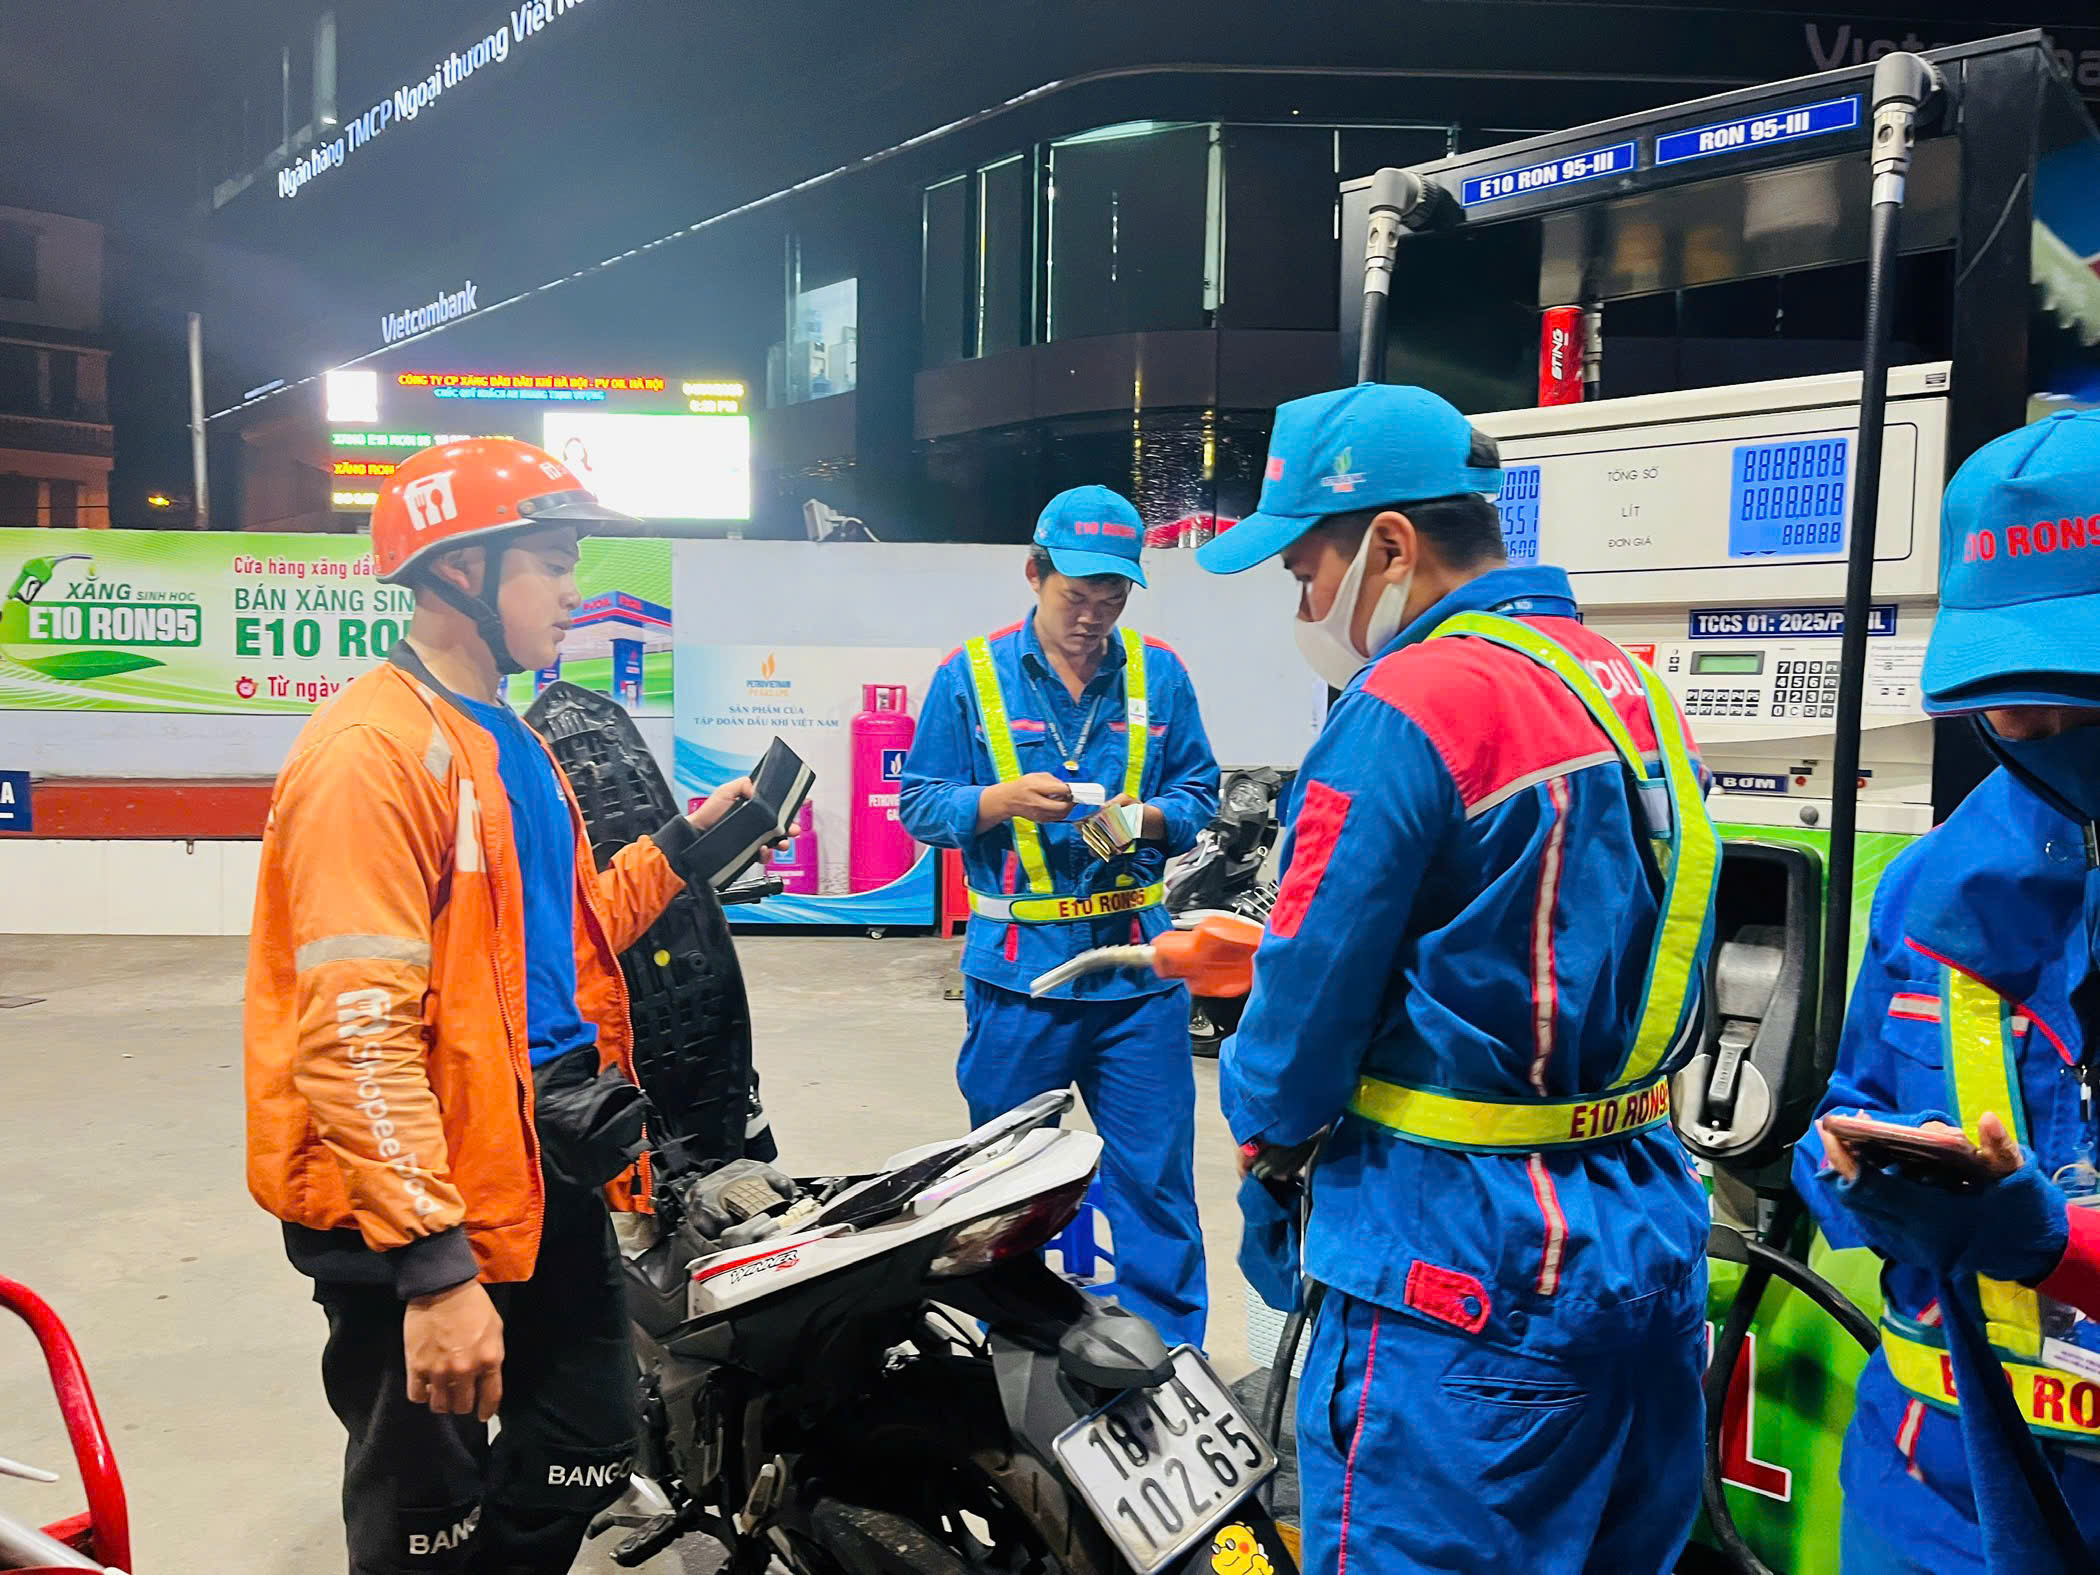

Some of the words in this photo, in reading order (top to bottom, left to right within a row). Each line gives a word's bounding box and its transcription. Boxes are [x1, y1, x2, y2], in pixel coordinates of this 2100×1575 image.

[279, 157, 312, 198] Ngân
[311, 141, 345, 177] hàng
[344, 99, 393, 152] TMCP
[394, 63, 442, 121] Ngoại
[1698, 126, 1745, 153] RON
[1749, 111, 1811, 141] 95-III
[1479, 174, 1515, 199] E10
[1517, 164, 1558, 190] RON
[1561, 151, 1615, 180] 95-III
[381, 280, 478, 344] Vietcombank
[234, 556, 264, 575] Cửa
[268, 556, 306, 580] hàng
[311, 558, 348, 580] xăng
[65, 575, 132, 601] XĂNG
[136, 591, 166, 601] SINH
[234, 583, 286, 611] BÁN
[295, 585, 364, 612] XĂNG
[28, 605, 83, 641] E10
[88, 607, 198, 643] RON95
[235, 617, 321, 658] E10
[1698, 614, 1743, 634] TCCS
[1746, 614, 1776, 633] 01:
[1778, 610, 1886, 632] 2025/PIL
[267, 674, 290, 697] Từ
[1584, 658, 1647, 699] OIL
[1722, 776, 1777, 790] BƠM
[1059, 901, 1093, 918] E10
[1568, 1100, 1619, 1139] E10
[1621, 1082, 1668, 1129] RON9
[1117, 1413, 1262, 1549] 102.65
